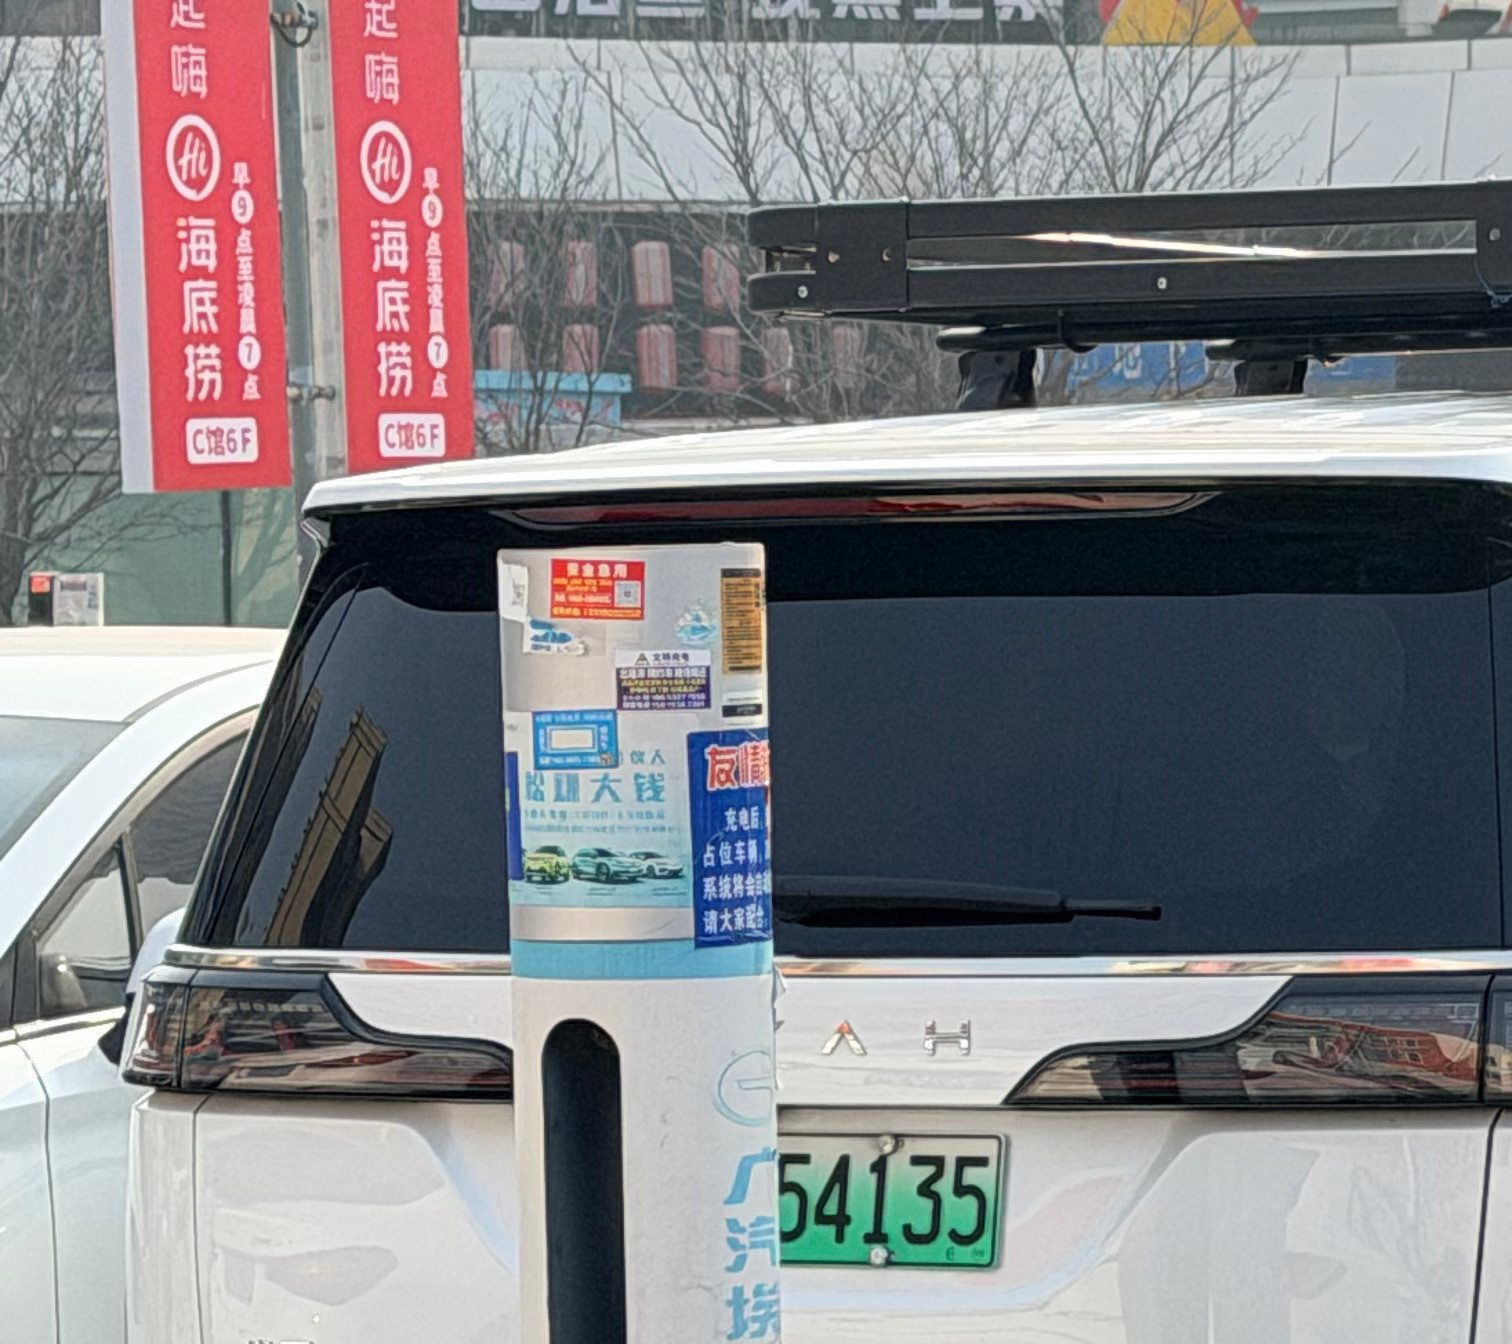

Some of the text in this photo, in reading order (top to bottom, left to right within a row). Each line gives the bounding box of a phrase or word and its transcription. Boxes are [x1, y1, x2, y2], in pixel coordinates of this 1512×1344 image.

[175, 215, 223, 403] 海底捞
[371, 218, 413, 398] 海底捞
[192, 419, 254, 458] C馆6F
[385, 415, 441, 452] C馆6F
[779, 1153, 991, 1245] 54135
